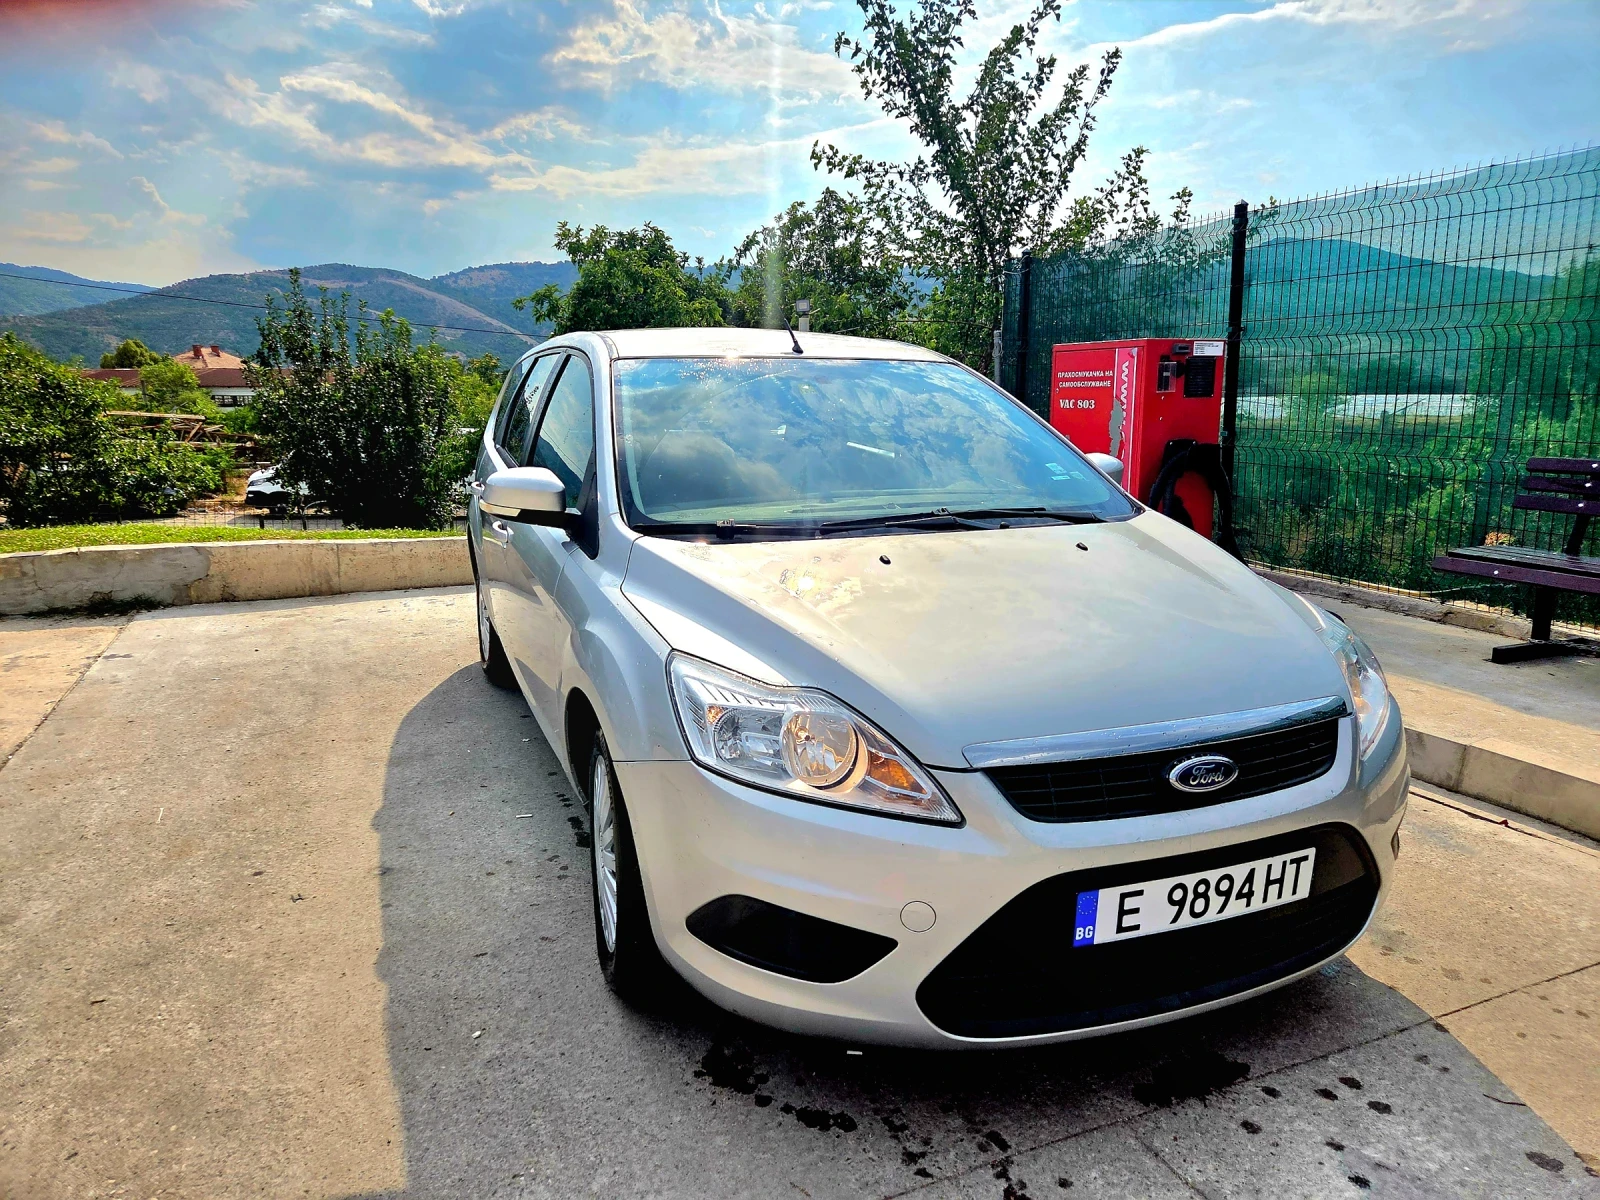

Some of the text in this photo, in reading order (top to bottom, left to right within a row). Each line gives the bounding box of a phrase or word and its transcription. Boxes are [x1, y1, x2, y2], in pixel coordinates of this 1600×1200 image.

[1059, 380, 1112, 388] САМООБСЛУЖВАНЕ
[1059, 399, 1096, 410] VAC 803
[1189, 764, 1225, 786] Ford
[1115, 854, 1310, 935] E 9894 HT
[1075, 925, 1094, 941] BG
